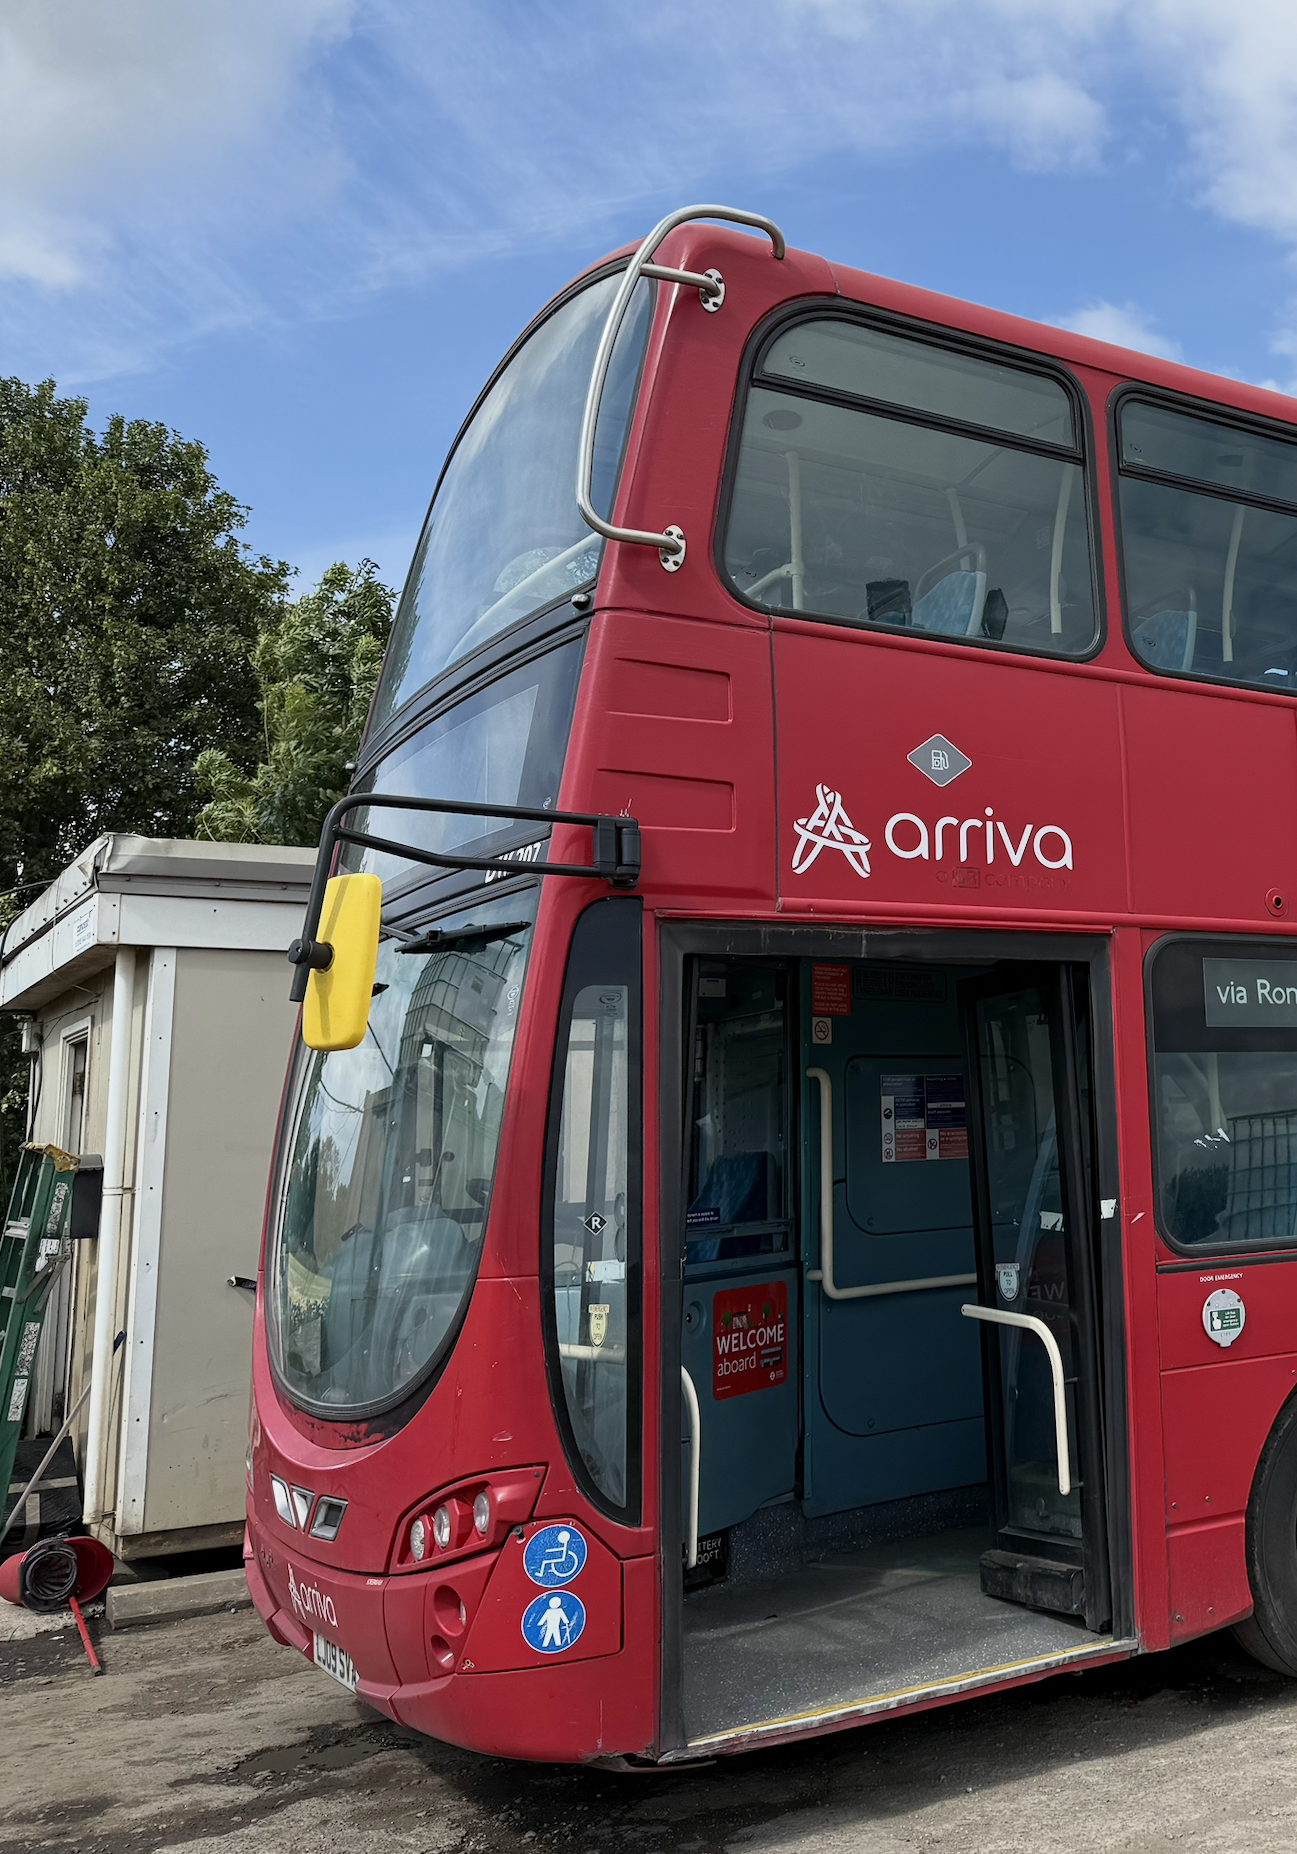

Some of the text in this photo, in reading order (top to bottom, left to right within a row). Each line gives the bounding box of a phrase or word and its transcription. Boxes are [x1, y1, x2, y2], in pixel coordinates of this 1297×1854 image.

[885, 806, 1073, 870] arriva
[1216, 980, 1248, 1004] via
[591, 1216, 602, 1230] R
[1200, 1273, 1244, 1283] DOOR EMERGENCY
[716, 1323, 785, 1356] WELCOME
[716, 1351, 757, 1377] aboard
[300, 1581, 339, 1628] arriva
